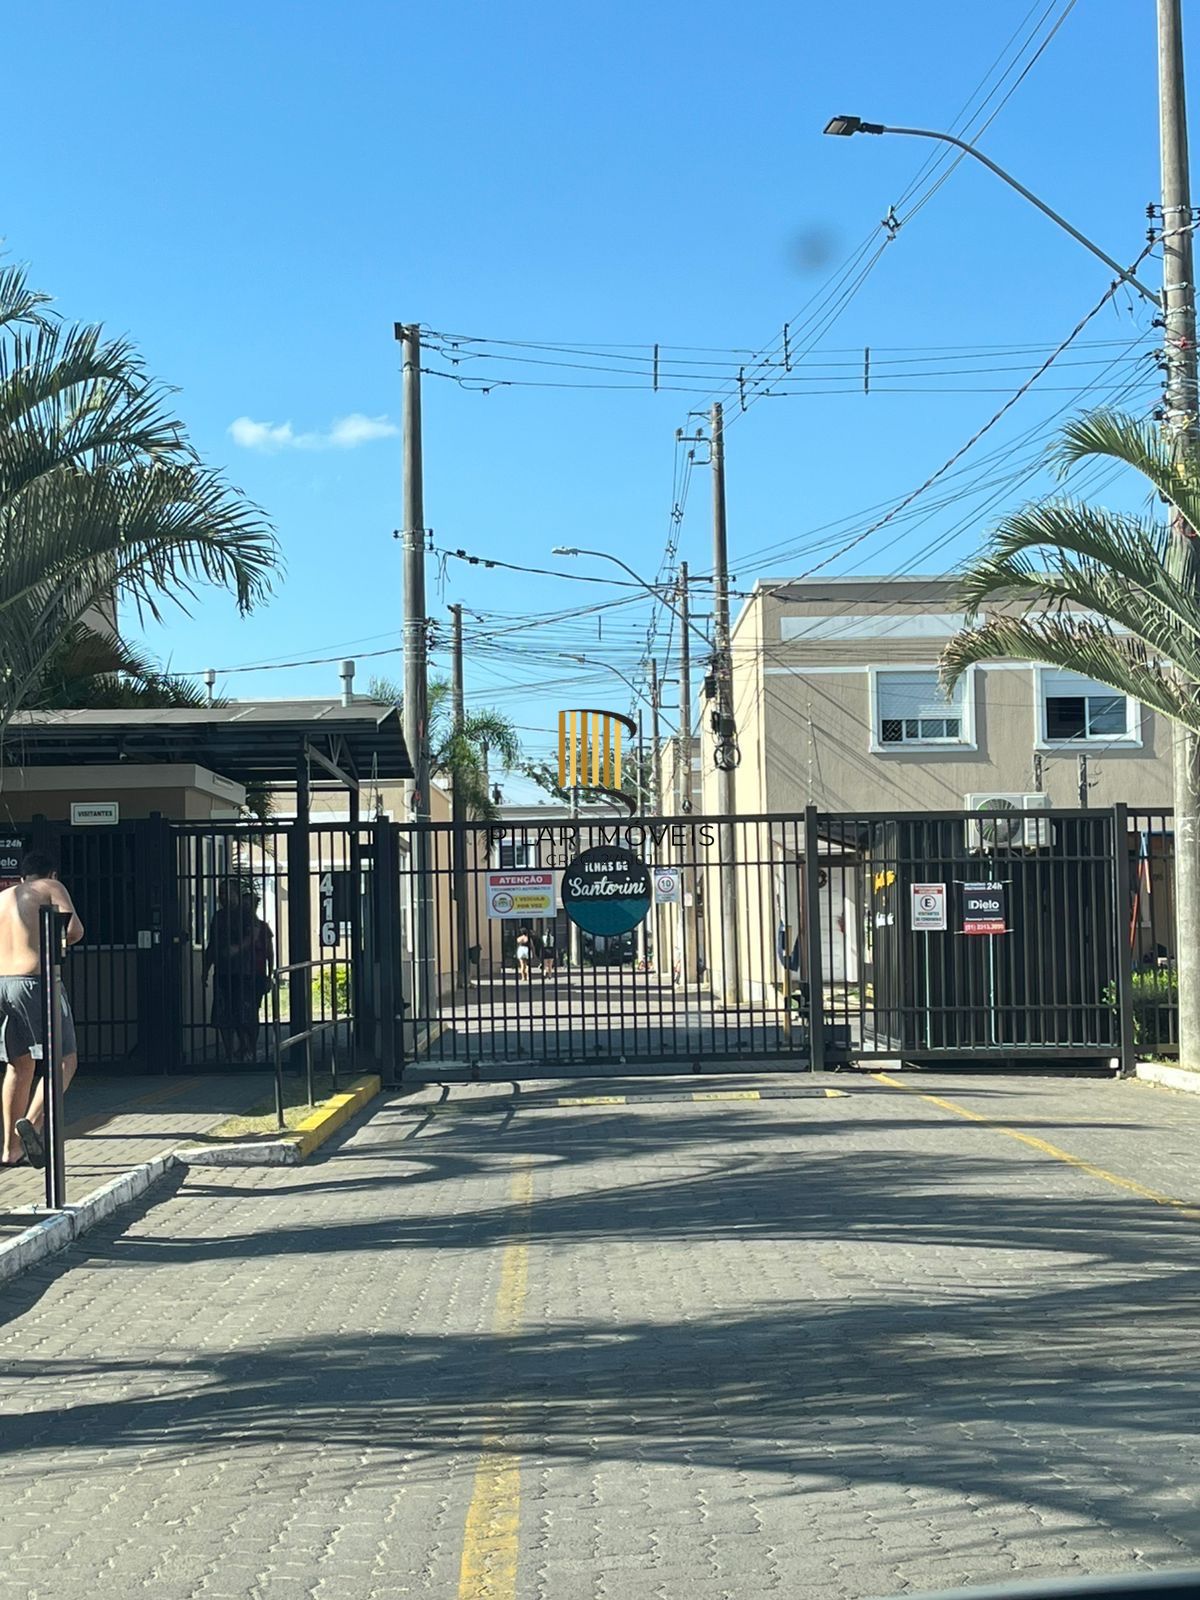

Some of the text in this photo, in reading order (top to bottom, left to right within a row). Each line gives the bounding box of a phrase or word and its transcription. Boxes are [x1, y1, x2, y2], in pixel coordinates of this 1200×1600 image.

[77, 810, 113, 818] VISITANTES
[5, 839, 22, 848] 24h
[0, 857, 18, 867] elo
[498, 876, 544, 885] ATENÇÃO
[661, 879, 672, 888] 10
[568, 875, 646, 897] Santorini
[987, 882, 1003, 890] 24h
[924, 898, 932, 907] E
[968, 899, 1000, 910] Dielo
[320, 872, 336, 946] 416
